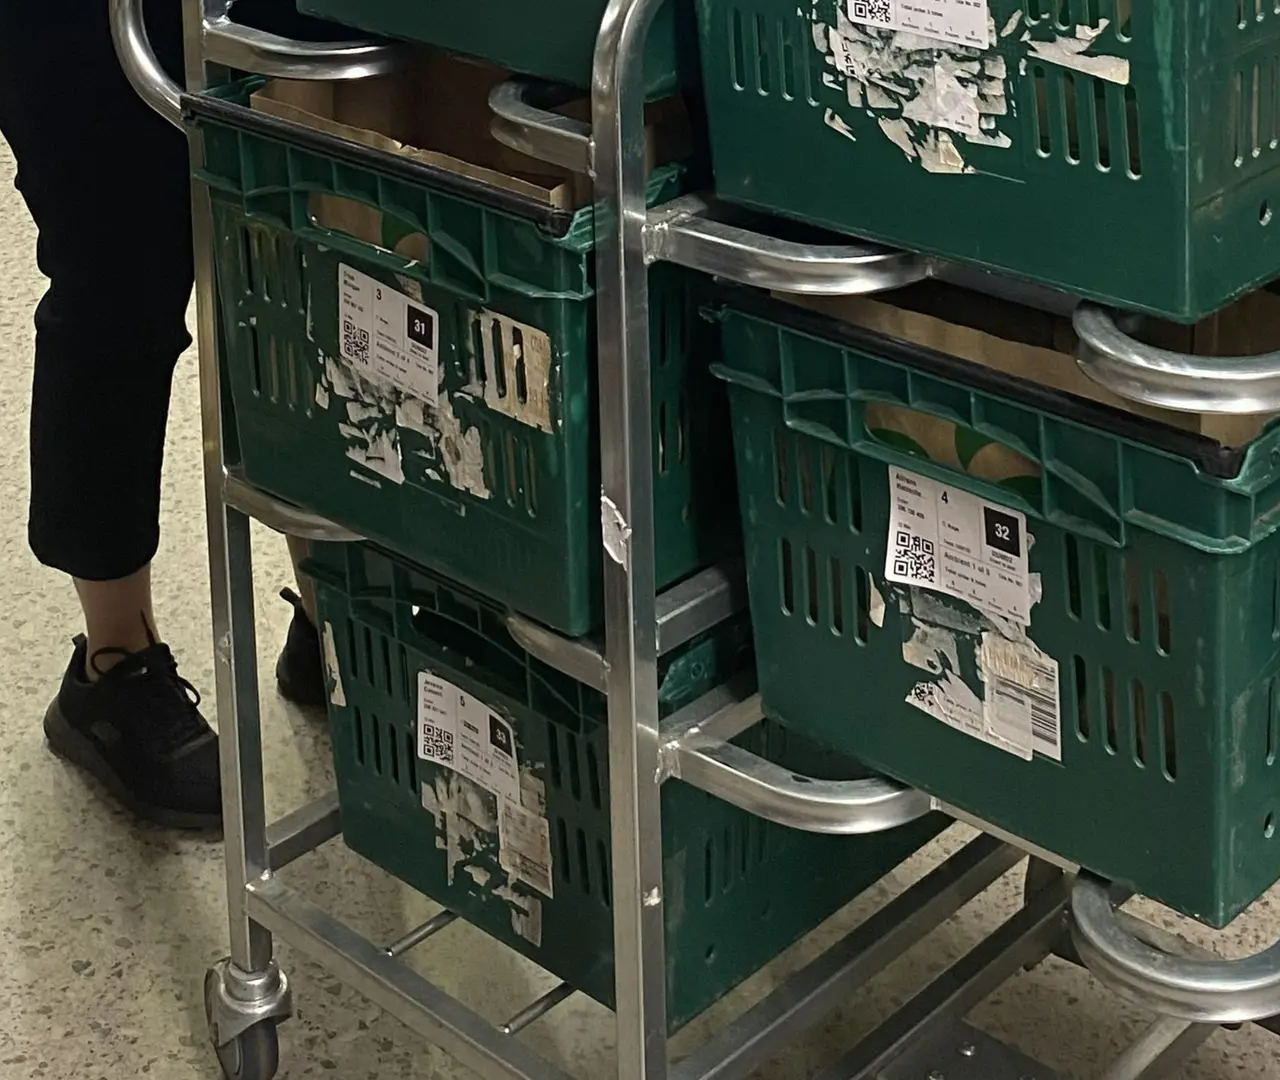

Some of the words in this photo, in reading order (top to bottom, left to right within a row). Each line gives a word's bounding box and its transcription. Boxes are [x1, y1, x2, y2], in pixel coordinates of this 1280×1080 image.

[414, 319, 425, 335] 31
[995, 523, 1010, 541] 32
[496, 729, 506, 744] 33
